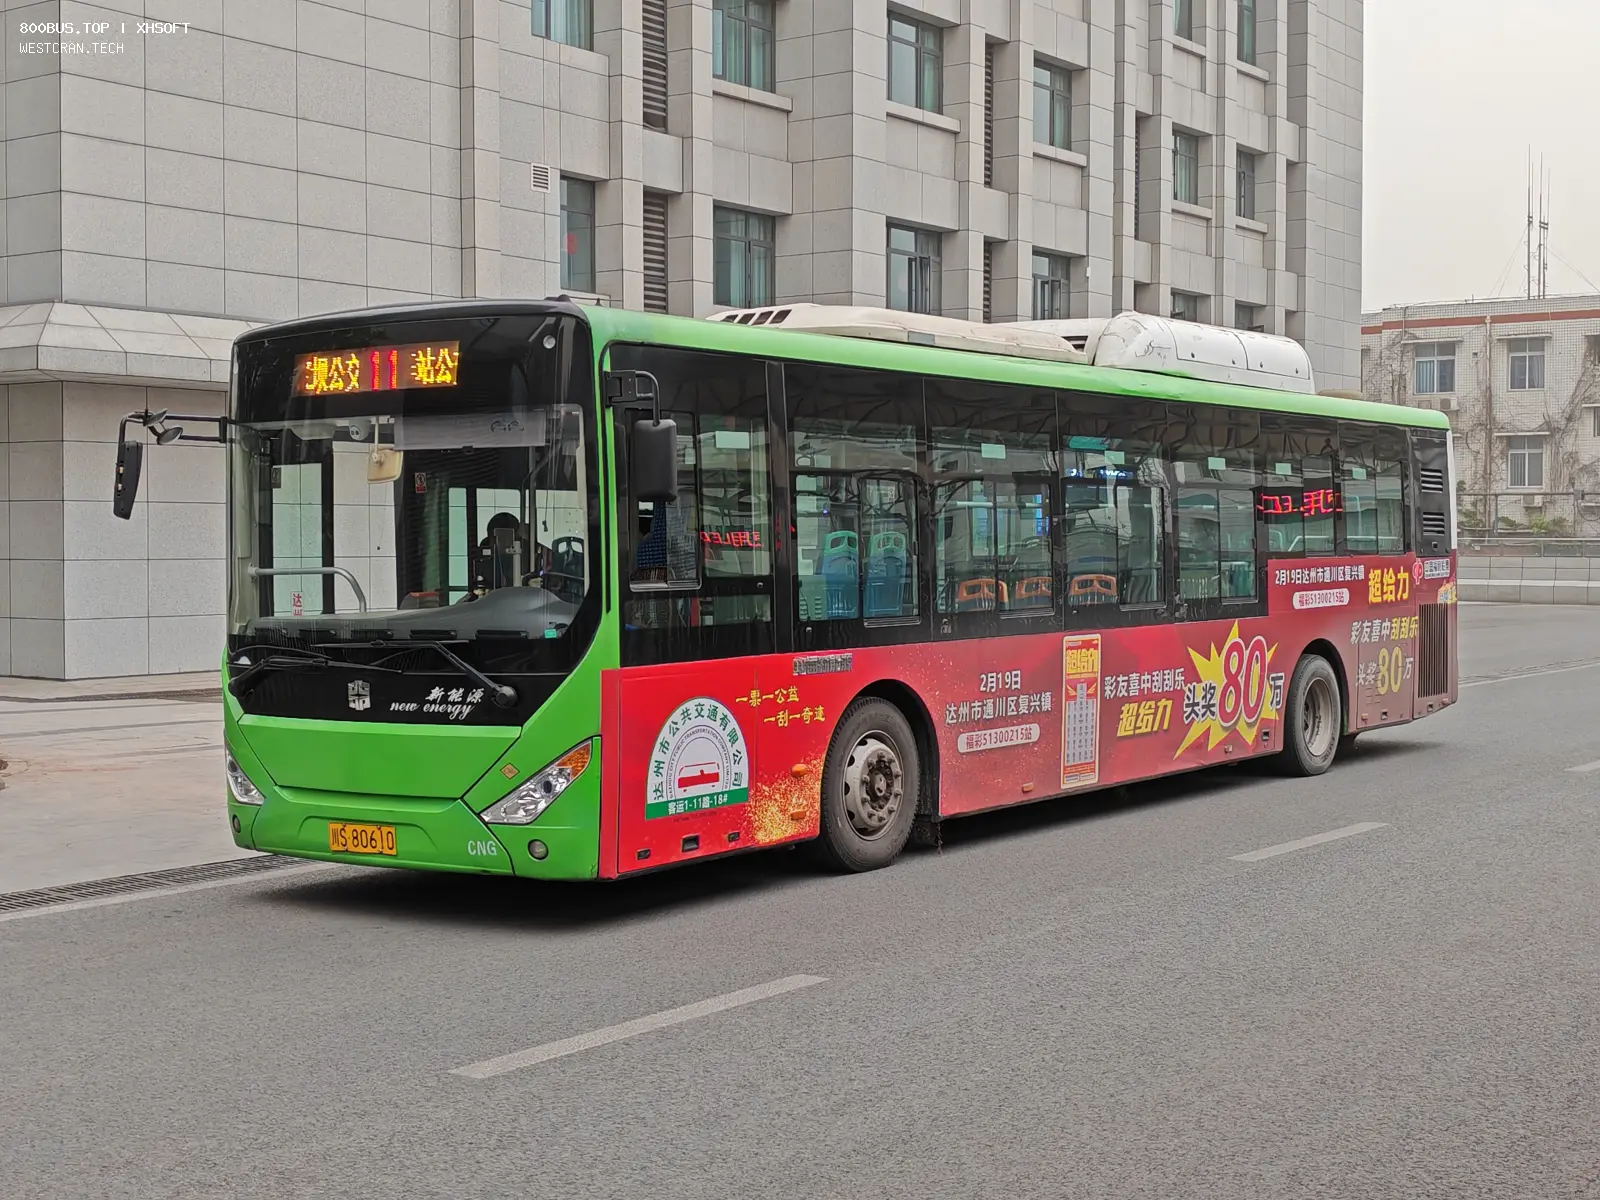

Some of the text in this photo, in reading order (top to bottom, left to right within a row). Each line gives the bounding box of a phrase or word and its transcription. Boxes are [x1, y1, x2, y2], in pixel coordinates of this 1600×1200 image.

[371, 349, 398, 392] 11
[1275, 564, 1365, 586] 2月19日达州市通川区复兴镇
[1368, 566, 1410, 605] 超给力
[1350, 615, 1418, 645] 彩友喜中刮刮乐
[979, 669, 1022, 693] 2月19日
[1104, 667, 1186, 700] 彩友喜中刮刮乐
[1183, 635, 1286, 728] 头奖80万
[1355, 646, 1414, 695] 头奖80万
[425, 686, 484, 703] 新能源
[735, 685, 800, 708] 一票一公益
[944, 691, 1053, 725] 达州市通川区复兴镇
[389, 701, 475, 720] new energy
[1116, 698, 1173, 738] 超给力
[652, 702, 744, 801] 达州市公共交通有限公司
[965, 726, 1033, 751] 福彩51300215站
[467, 840, 498, 857] CNG
